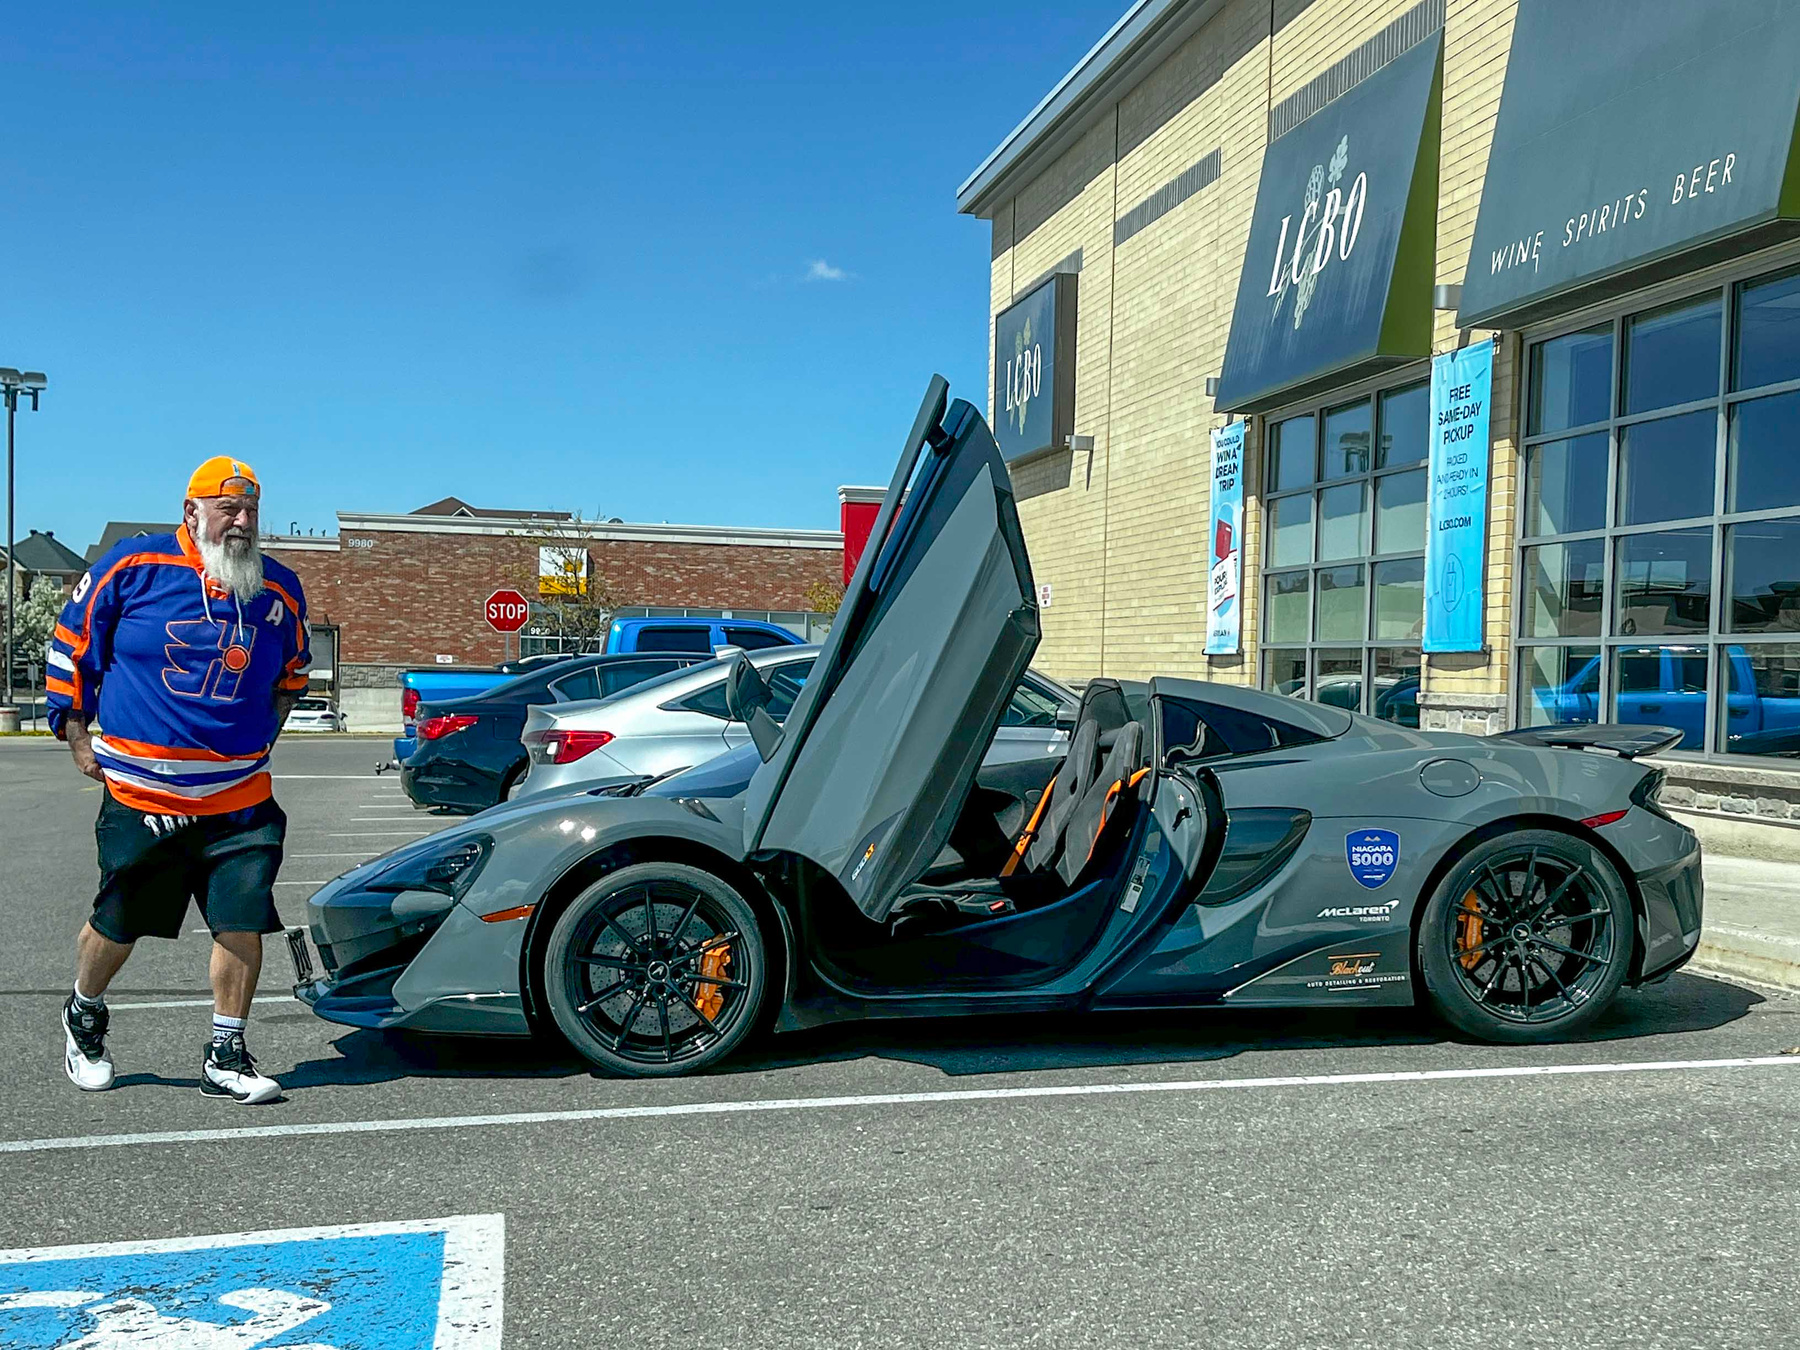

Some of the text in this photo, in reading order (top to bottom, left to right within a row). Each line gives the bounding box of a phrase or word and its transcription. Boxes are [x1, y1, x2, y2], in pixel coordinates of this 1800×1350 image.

[1491, 153, 1736, 275] WINE SPIRITS BEER
[1266, 172, 1367, 297] LCBO
[1005, 343, 1042, 411] LCBO
[1449, 384, 1471, 403] FREE
[1438, 401, 1482, 426] SAME-DAY
[1444, 424, 1474, 445] PICKUP
[1219, 478, 1235, 492] TRIP
[348, 538, 373, 548] 9980
[265, 599, 284, 626] A
[488, 603, 527, 619] STOP
[1352, 853, 1394, 866] 5000
[1317, 904, 1392, 918] McLaren
